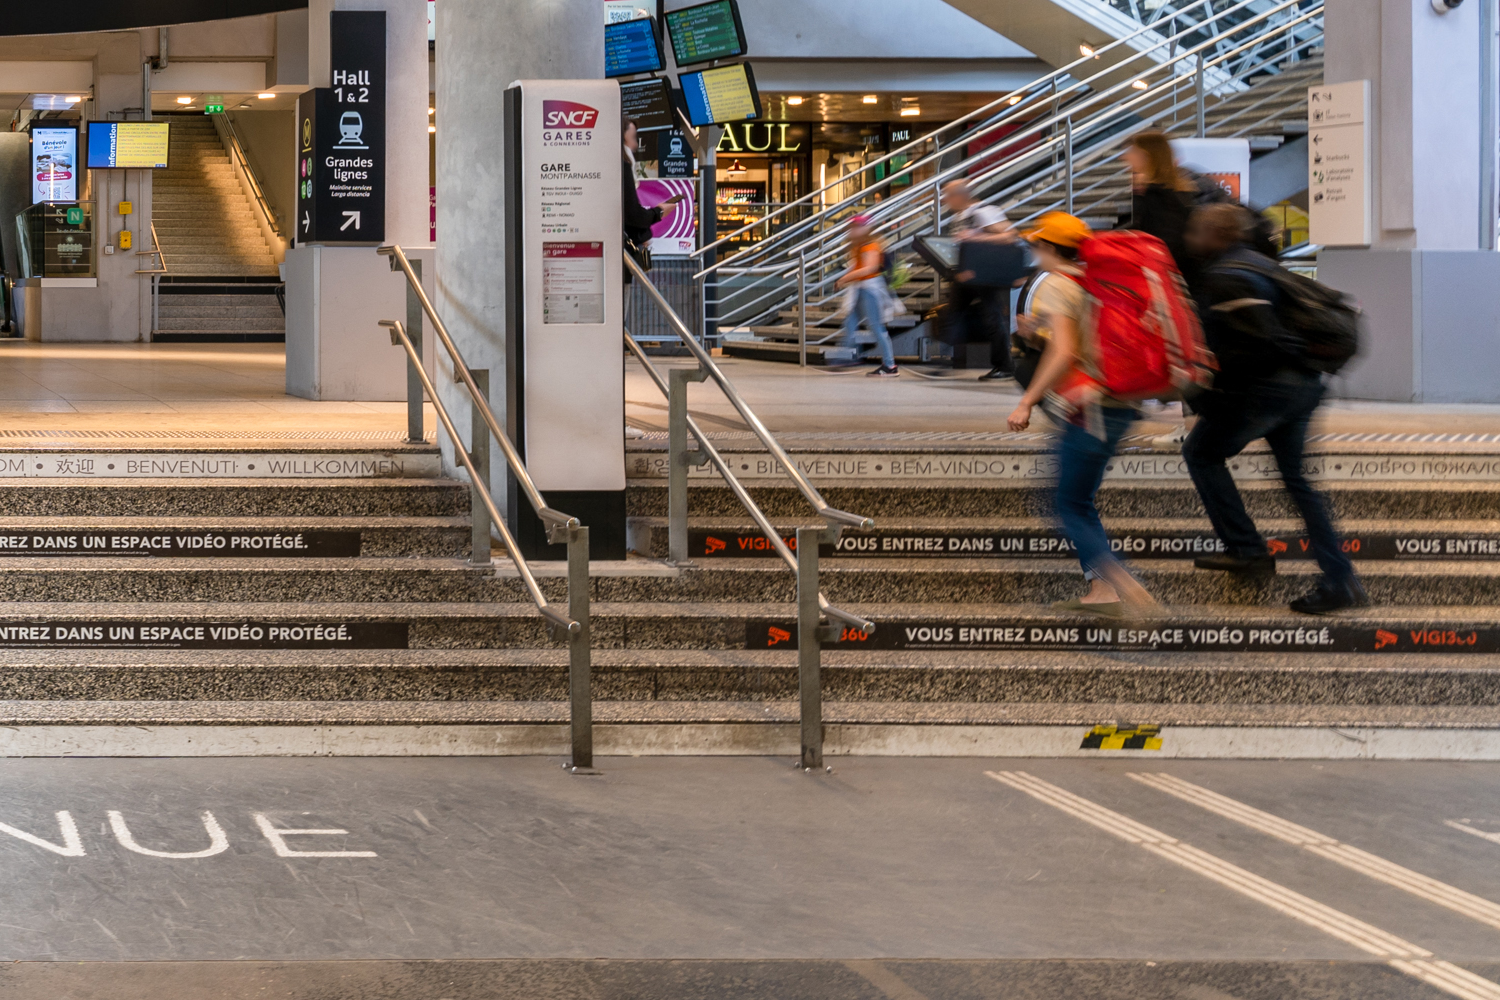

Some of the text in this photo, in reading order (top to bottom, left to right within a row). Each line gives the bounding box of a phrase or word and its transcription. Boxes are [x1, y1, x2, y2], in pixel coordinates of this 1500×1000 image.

[333, 70, 371, 85] Hall
[334, 87, 369, 103] 1 & 2
[697, 72, 714, 124] information
[545, 110, 596, 126] SNCF
[543, 131, 592, 141] GARES
[715, 123, 801, 151] AUL
[892, 130, 911, 142] PAUL
[108, 123, 117, 167] information
[325, 156, 373, 168] Grandes
[541, 163, 571, 172] GARE
[334, 168, 368, 182] lignes
[541, 172, 602, 180] MONTPARNASSE
[56, 458, 95, 476] 欢迎
[126, 460, 237, 474] BENVENUTI
[267, 460, 405, 475] WILLKOMMEN
[891, 460, 1005, 475] BEM-VINDO
[1350, 460, 1417, 478] ДОБРО
[34, 536, 77, 549] DANS
[82, 536, 106, 549] UN
[112, 536, 171, 549] ESPACE
[177, 533, 226, 549] VIDÉO
[232, 533, 308, 549] PROTÉGÉ.
[884, 538, 943, 551] ENTREZ
[949, 538, 993, 551] DANS
[1000, 538, 1024, 551] UN
[1395, 539, 1441, 553] VOUS
[56, 627, 103, 640] DANS
[109, 627, 134, 640] UN
[141, 627, 205, 640] ESPACE
[210, 624, 264, 640] VIDÉO
[270, 624, 352, 640] PROTÉGÉ.
[905, 626, 1335, 643] VOUS ENTREZ DANS UN ESPACE VIDÉO PROTÉGÉ.
